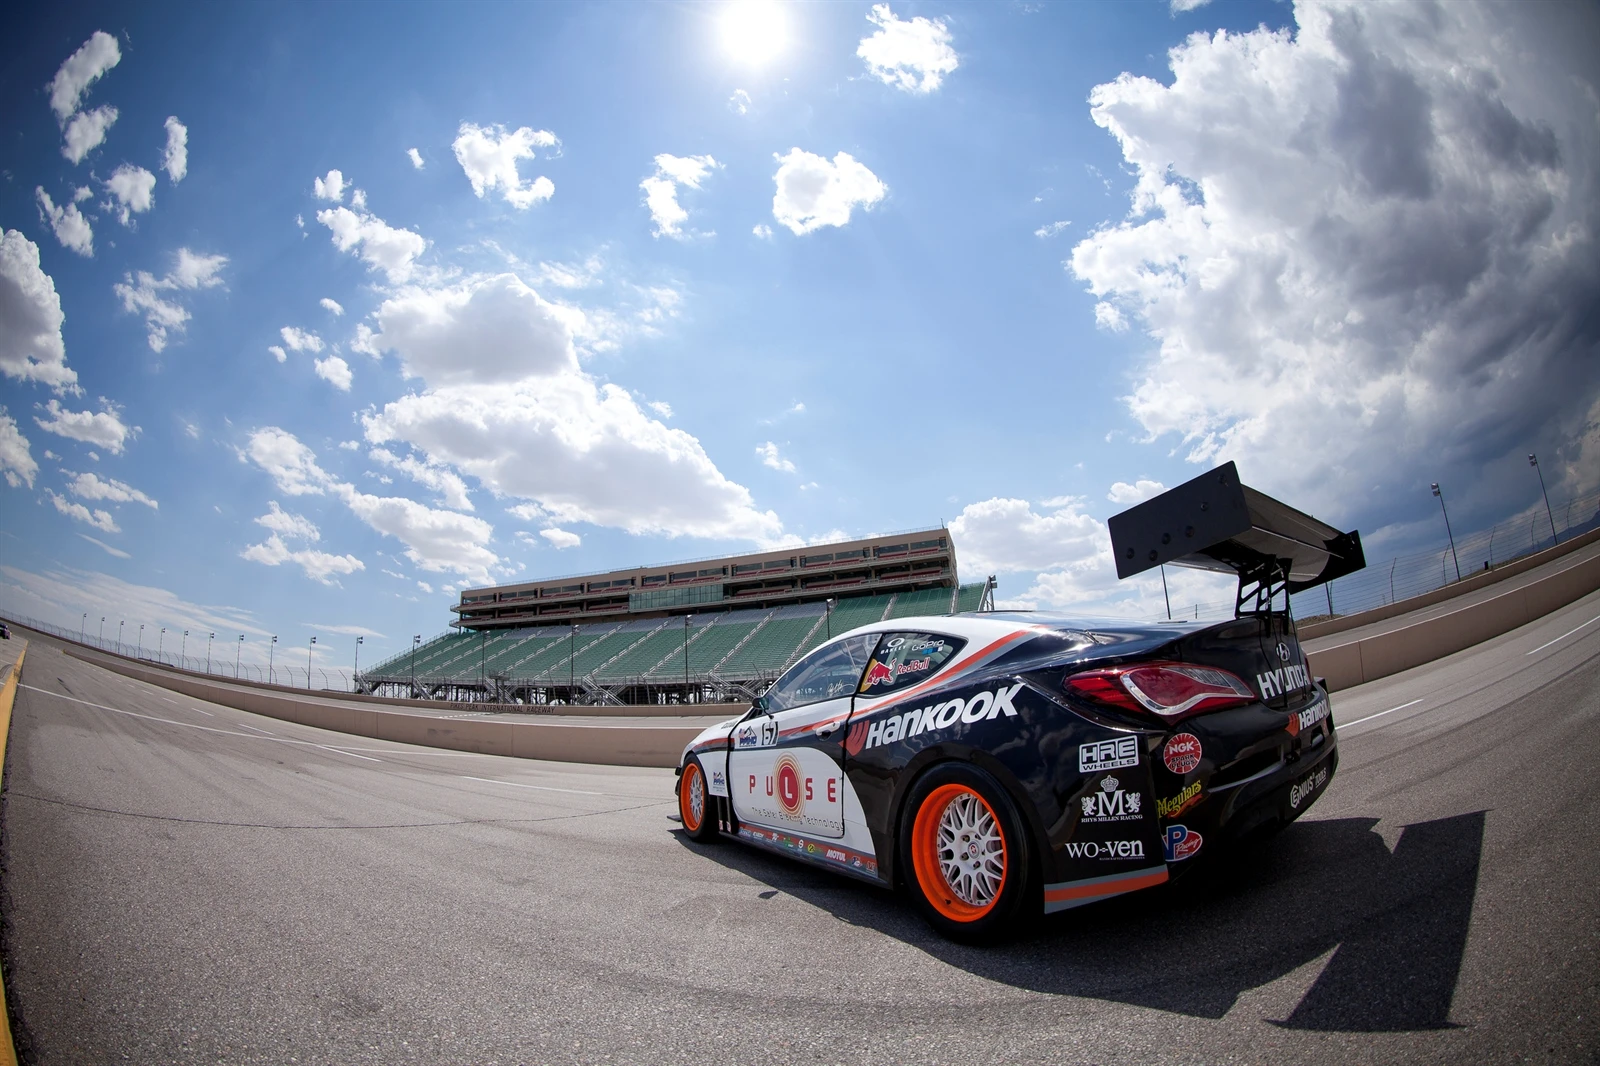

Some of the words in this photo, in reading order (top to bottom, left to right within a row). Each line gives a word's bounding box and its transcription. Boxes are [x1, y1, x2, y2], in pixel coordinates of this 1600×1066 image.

[1257, 664, 1310, 700] HYUNDA
[1082, 739, 1136, 764] HRE
[1169, 741, 1194, 754] NGK
[1082, 758, 1136, 771] WHEELS
[1171, 754, 1195, 763] SPARK
[1171, 760, 1194, 768] PLUGS
[1315, 767, 1327, 785] TOOLS
[750, 774, 836, 802] PULSE
[804, 814, 844, 832] Technology
[826, 849, 846, 862] MOTUL
